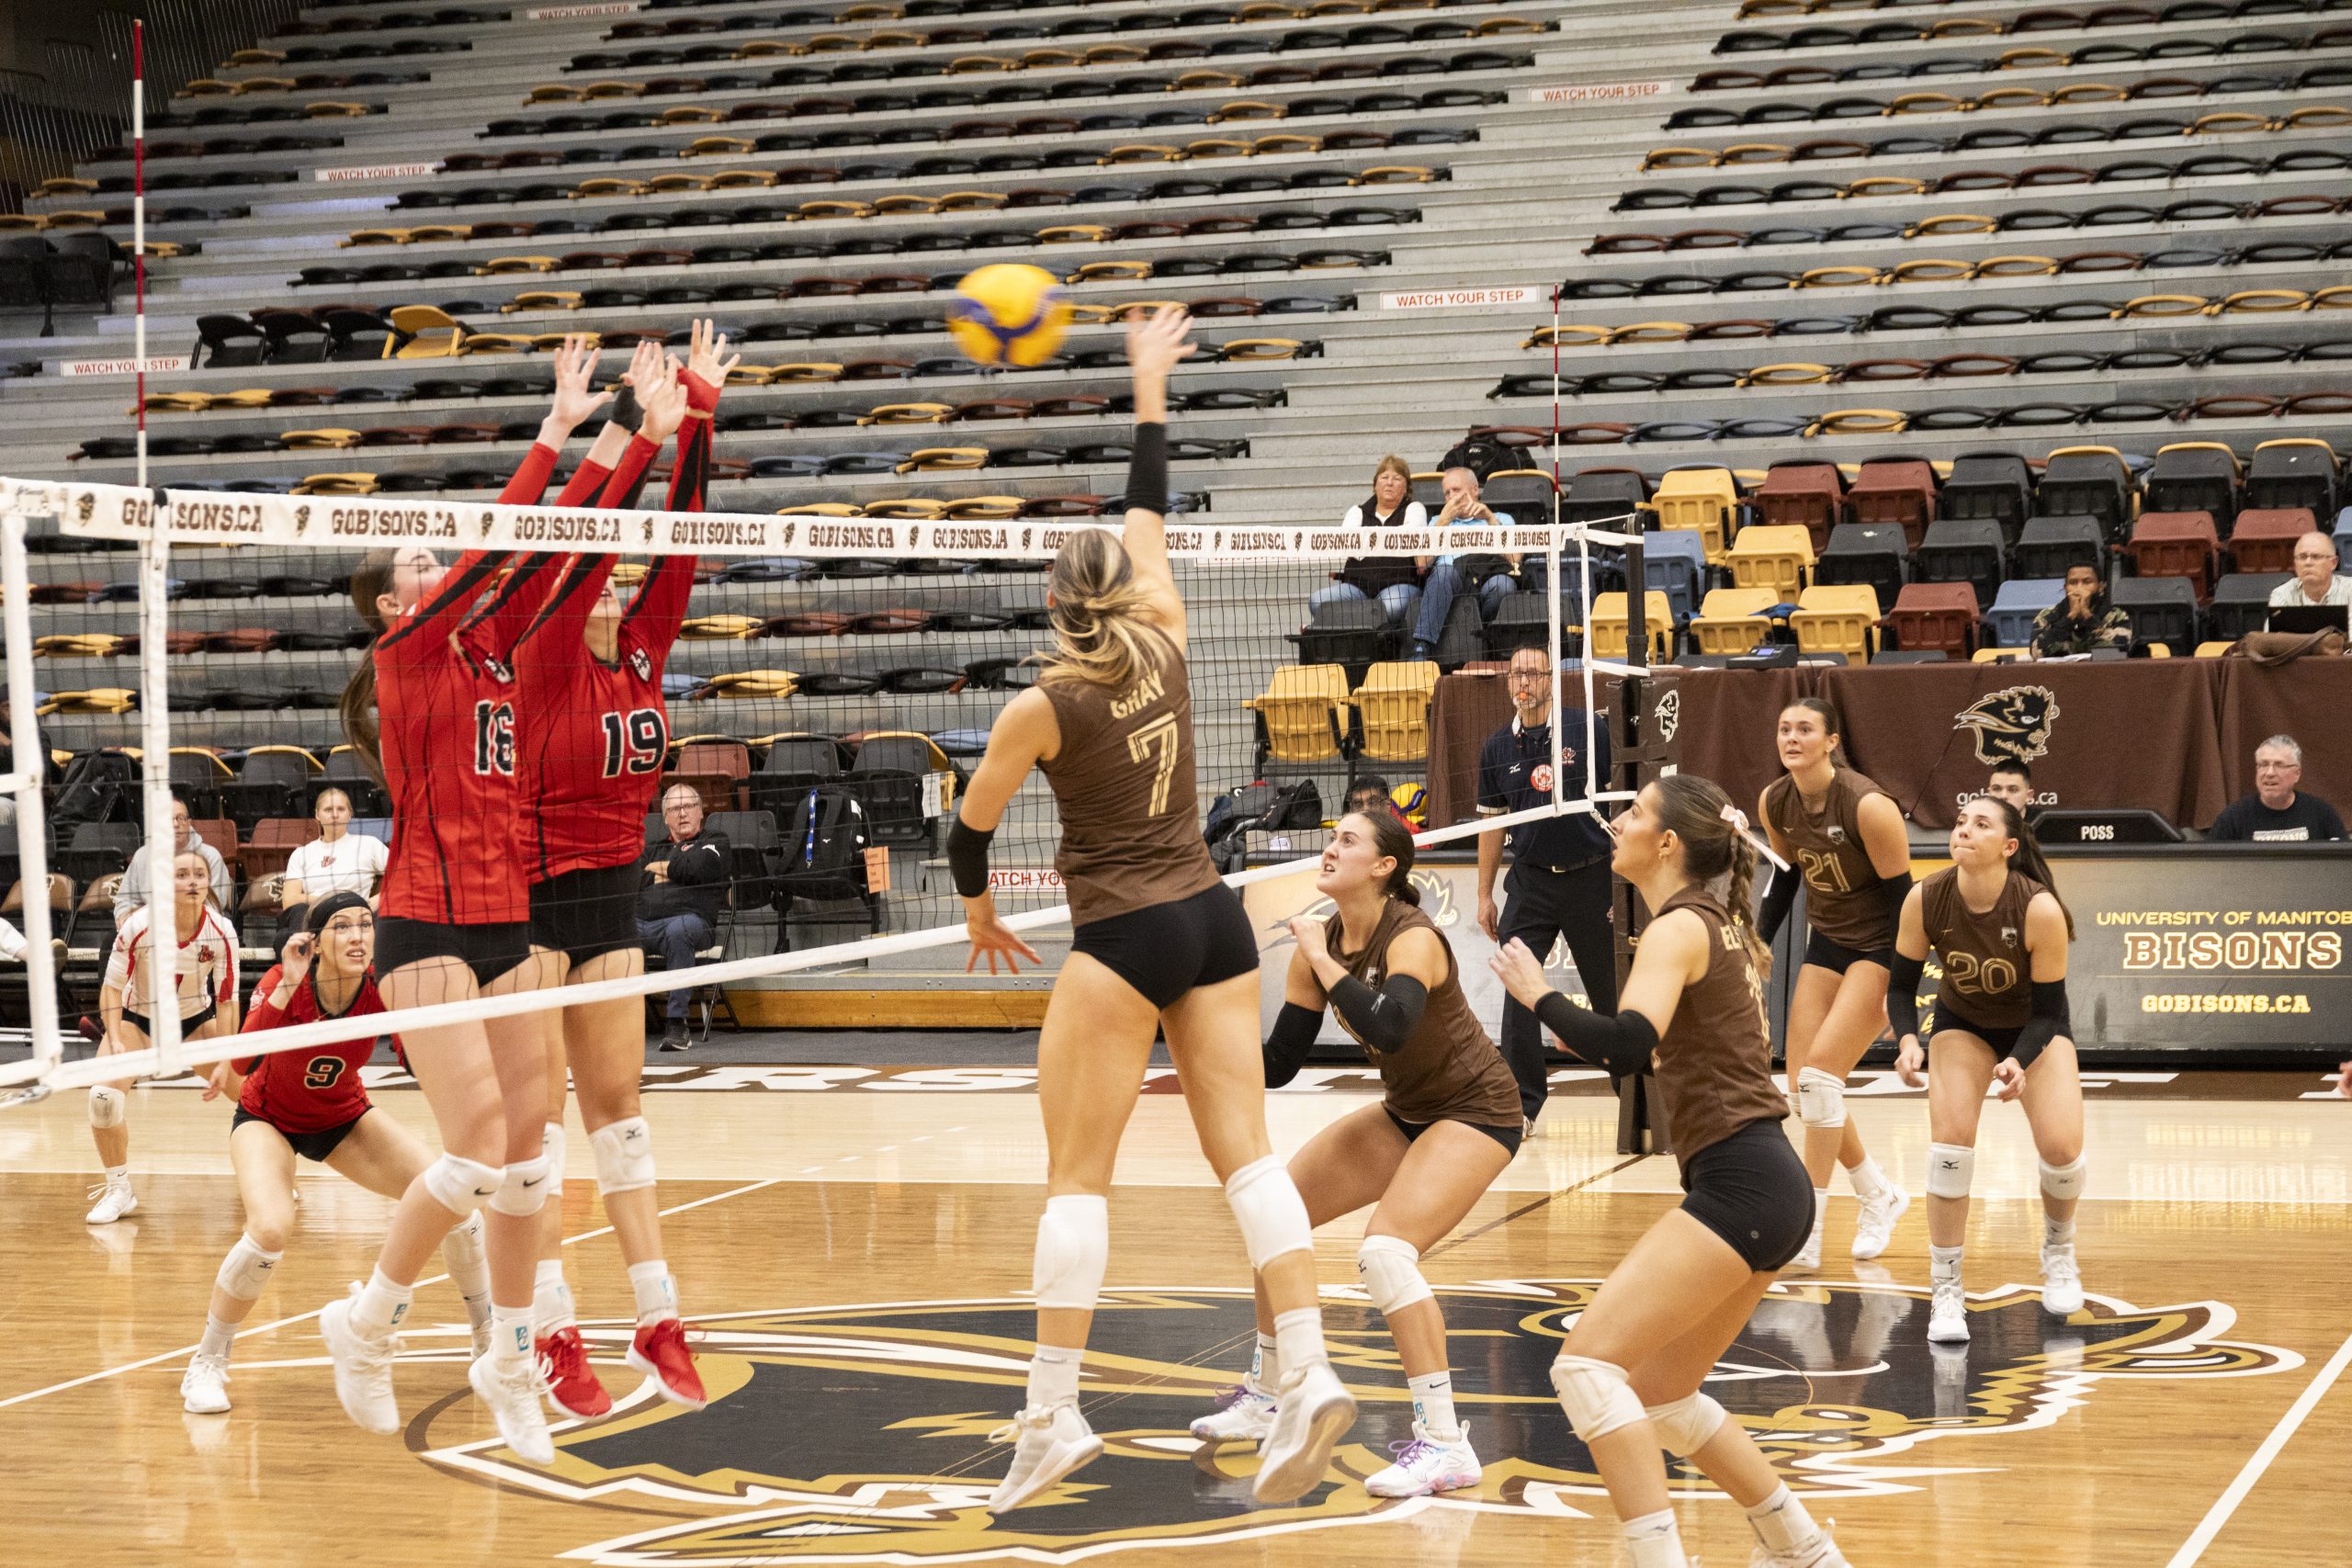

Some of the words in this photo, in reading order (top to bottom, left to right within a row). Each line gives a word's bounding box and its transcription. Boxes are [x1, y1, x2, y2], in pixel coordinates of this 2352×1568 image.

[538, 8, 572, 20] WATCH
[575, 6, 602, 17] YOUR
[605, 4, 629, 14] STEP
[1544, 88, 1586, 102] WATCH
[1590, 86, 1623, 99] YOUR
[1628, 84, 1659, 96] STEP
[328, 170, 364, 181] WATCH
[368, 168, 396, 179] YOUR
[399, 166, 424, 176] STEP
[1396, 294, 1443, 307] WATCH
[1448, 292, 1485, 304] YOUR
[1489, 290, 1523, 302] STEP
[74, 364, 113, 374] WATCH
[117, 362, 147, 372] YOU
[151, 359, 179, 370] STEP
[122, 498, 264, 533] GOSONS.CA
[332, 509, 458, 537] GOBISONS.CA
[514, 515, 621, 542] GOBISONS.CA
[671, 521, 766, 546] GOBISONS.CA
[808, 525, 895, 548] GOBISONS.CA
[1110, 670, 1166, 719] GRAY
[474, 699, 516, 776] 16
[602, 708, 668, 779] 19
[1126, 711, 1179, 818] 7
[2081, 825, 2115, 841] POSS
[988, 872, 1032, 886] ATCH
[1797, 848, 1851, 893] 21
[2096, 911, 2220, 926] UNIVERSITY
[2223, 911, 2253, 926] OF
[2122, 931, 2343, 970] BISONS
[1946, 950, 2018, 995] 20
[2141, 994, 2312, 1013] GOBISONS.CA
[304, 1055, 347, 1089] 9
